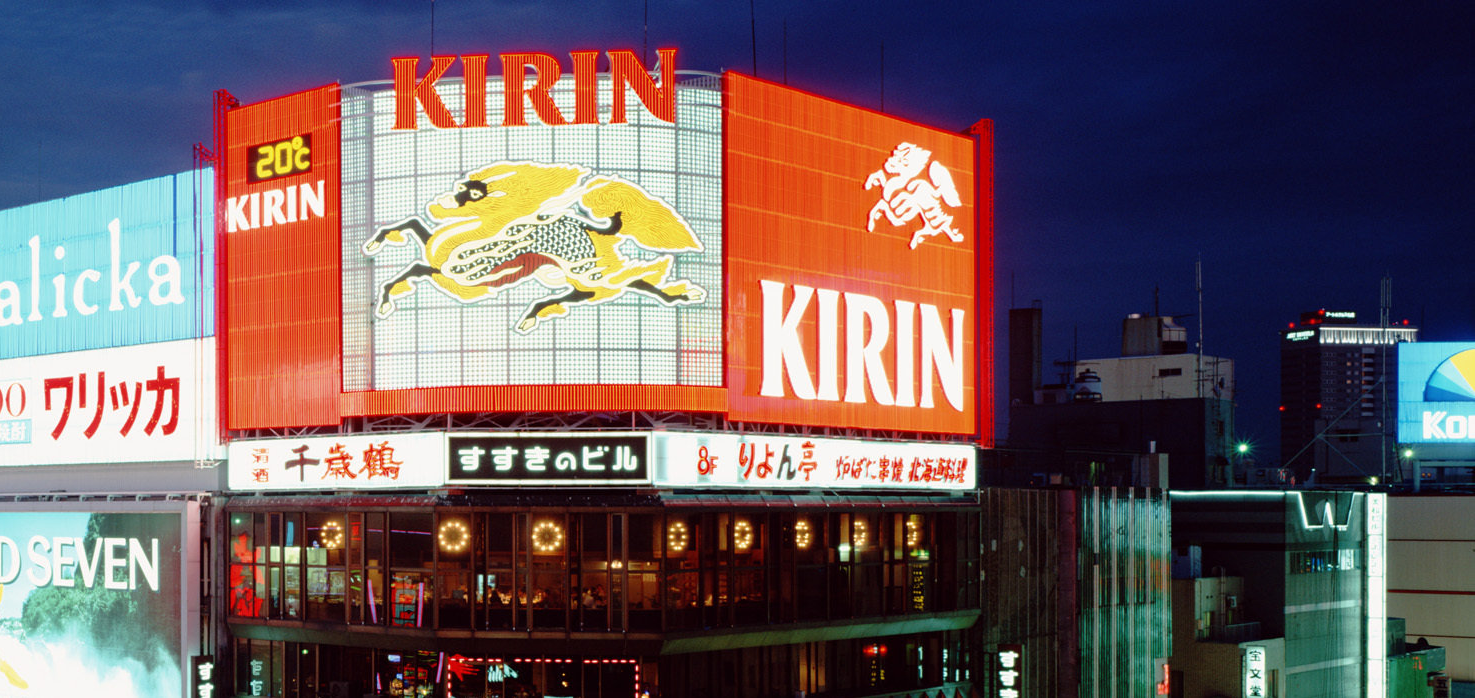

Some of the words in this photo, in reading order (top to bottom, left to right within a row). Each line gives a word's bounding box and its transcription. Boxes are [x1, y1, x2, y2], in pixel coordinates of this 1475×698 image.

[391, 48, 677, 131] KIRIN
[226, 180, 325, 232] KIRIN
[758, 279, 965, 412] KIRIN
[44, 365, 180, 440] ワリッカ
[252, 447, 269, 483] 清酒
[285, 441, 403, 481] 千歳鶴
[458, 444, 638, 472] すすきのビル
[697, 445, 719, 476] 8F
[27, 534, 160, 592] SEVEN
